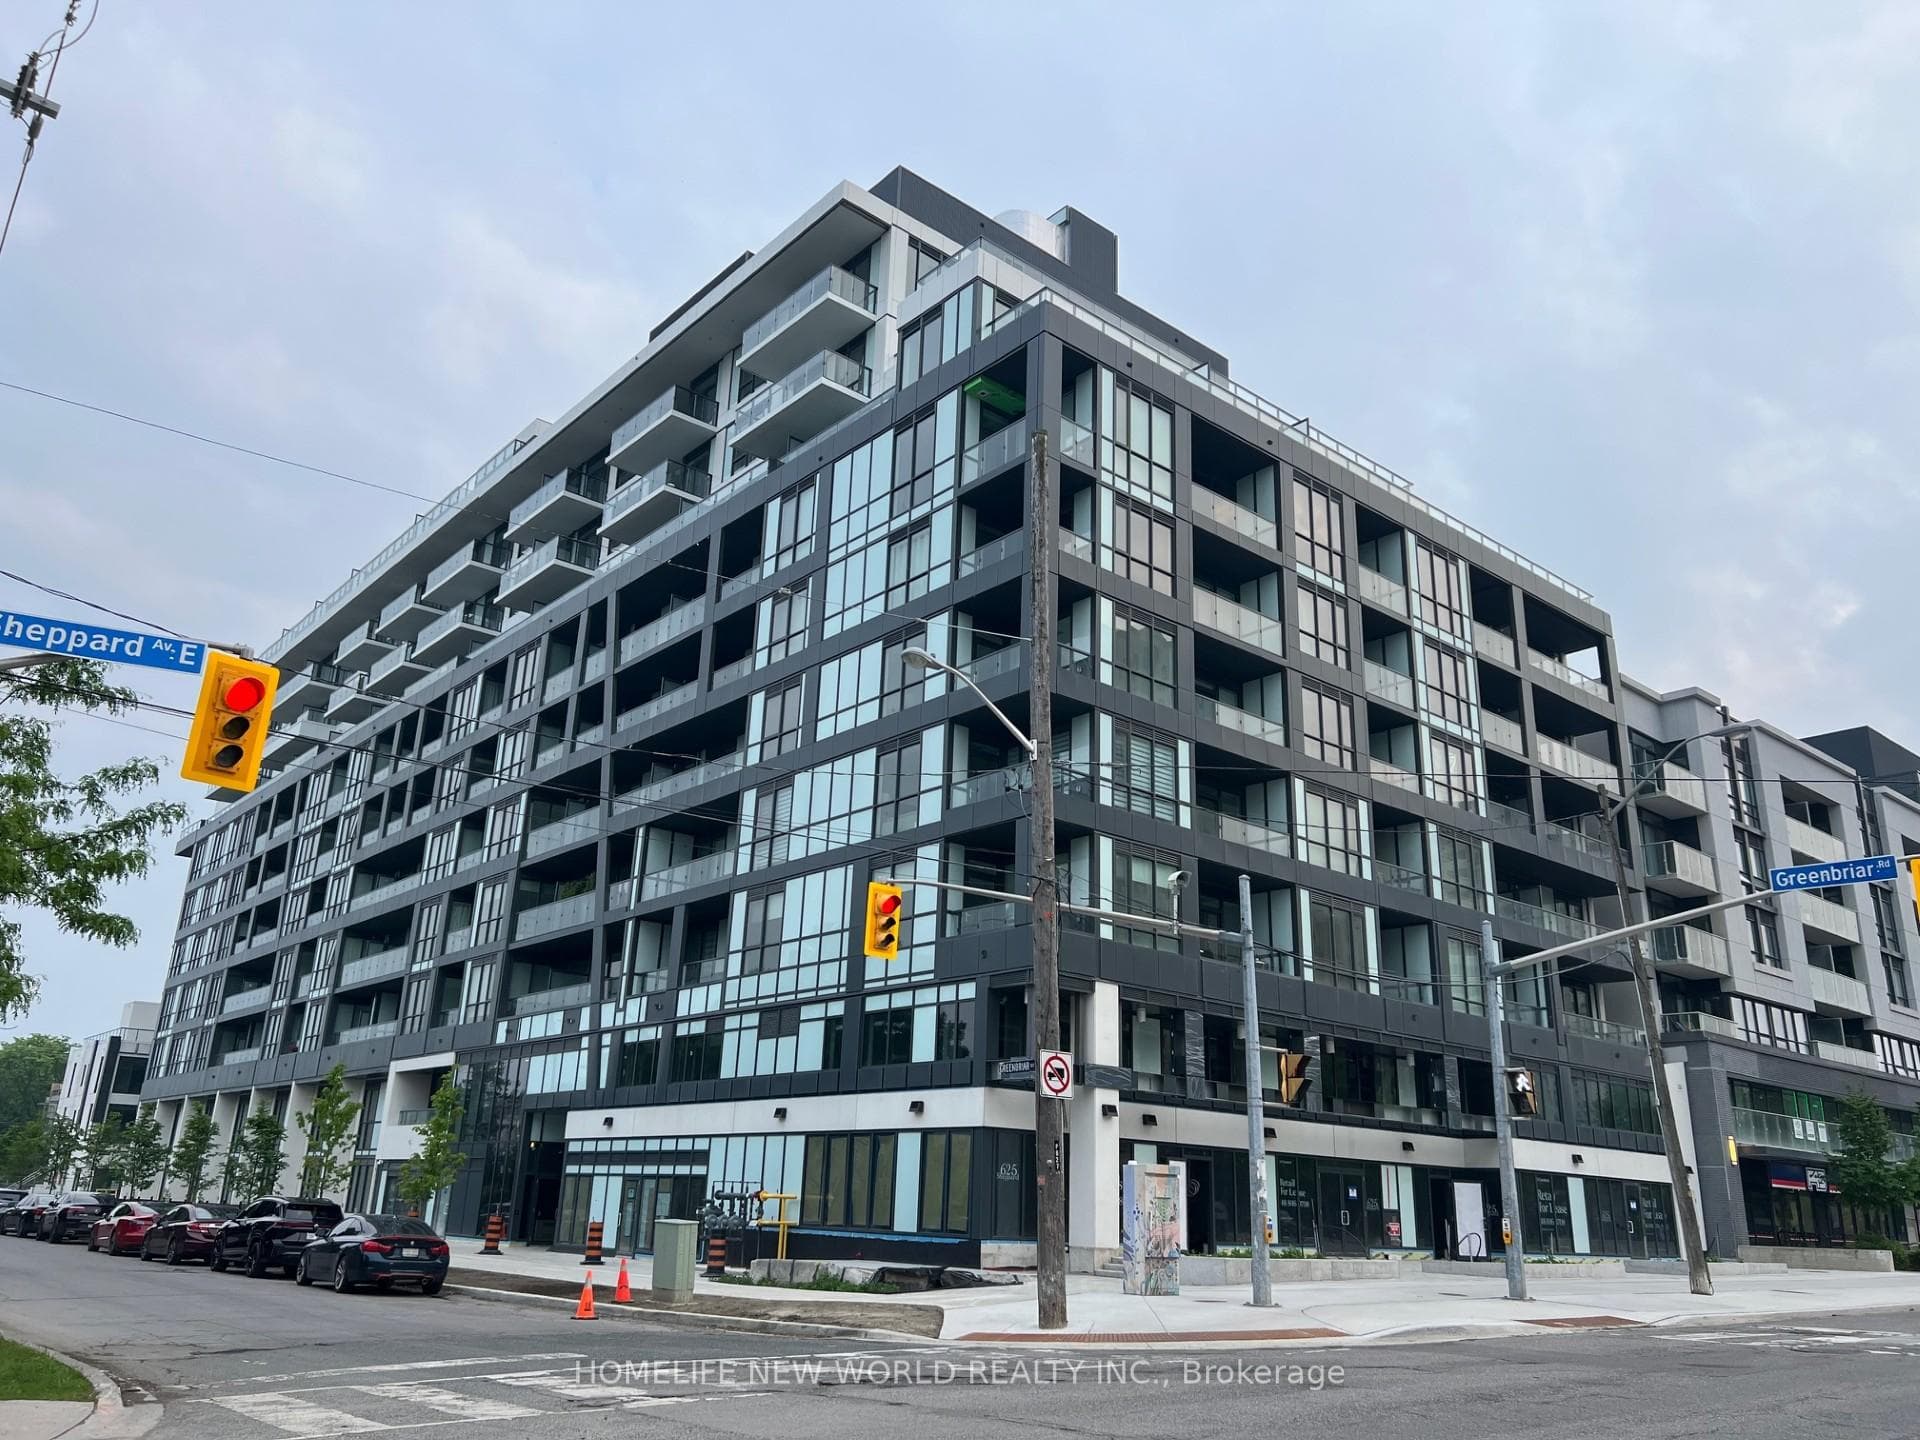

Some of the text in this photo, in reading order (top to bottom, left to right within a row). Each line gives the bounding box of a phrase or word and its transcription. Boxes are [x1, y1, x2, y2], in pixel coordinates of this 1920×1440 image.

[0, 613, 144, 657] heppard
[179, 642, 198, 666] E
[1776, 859, 1890, 887] Greenbriar Rd
[1000, 1162, 1018, 1175] 625
